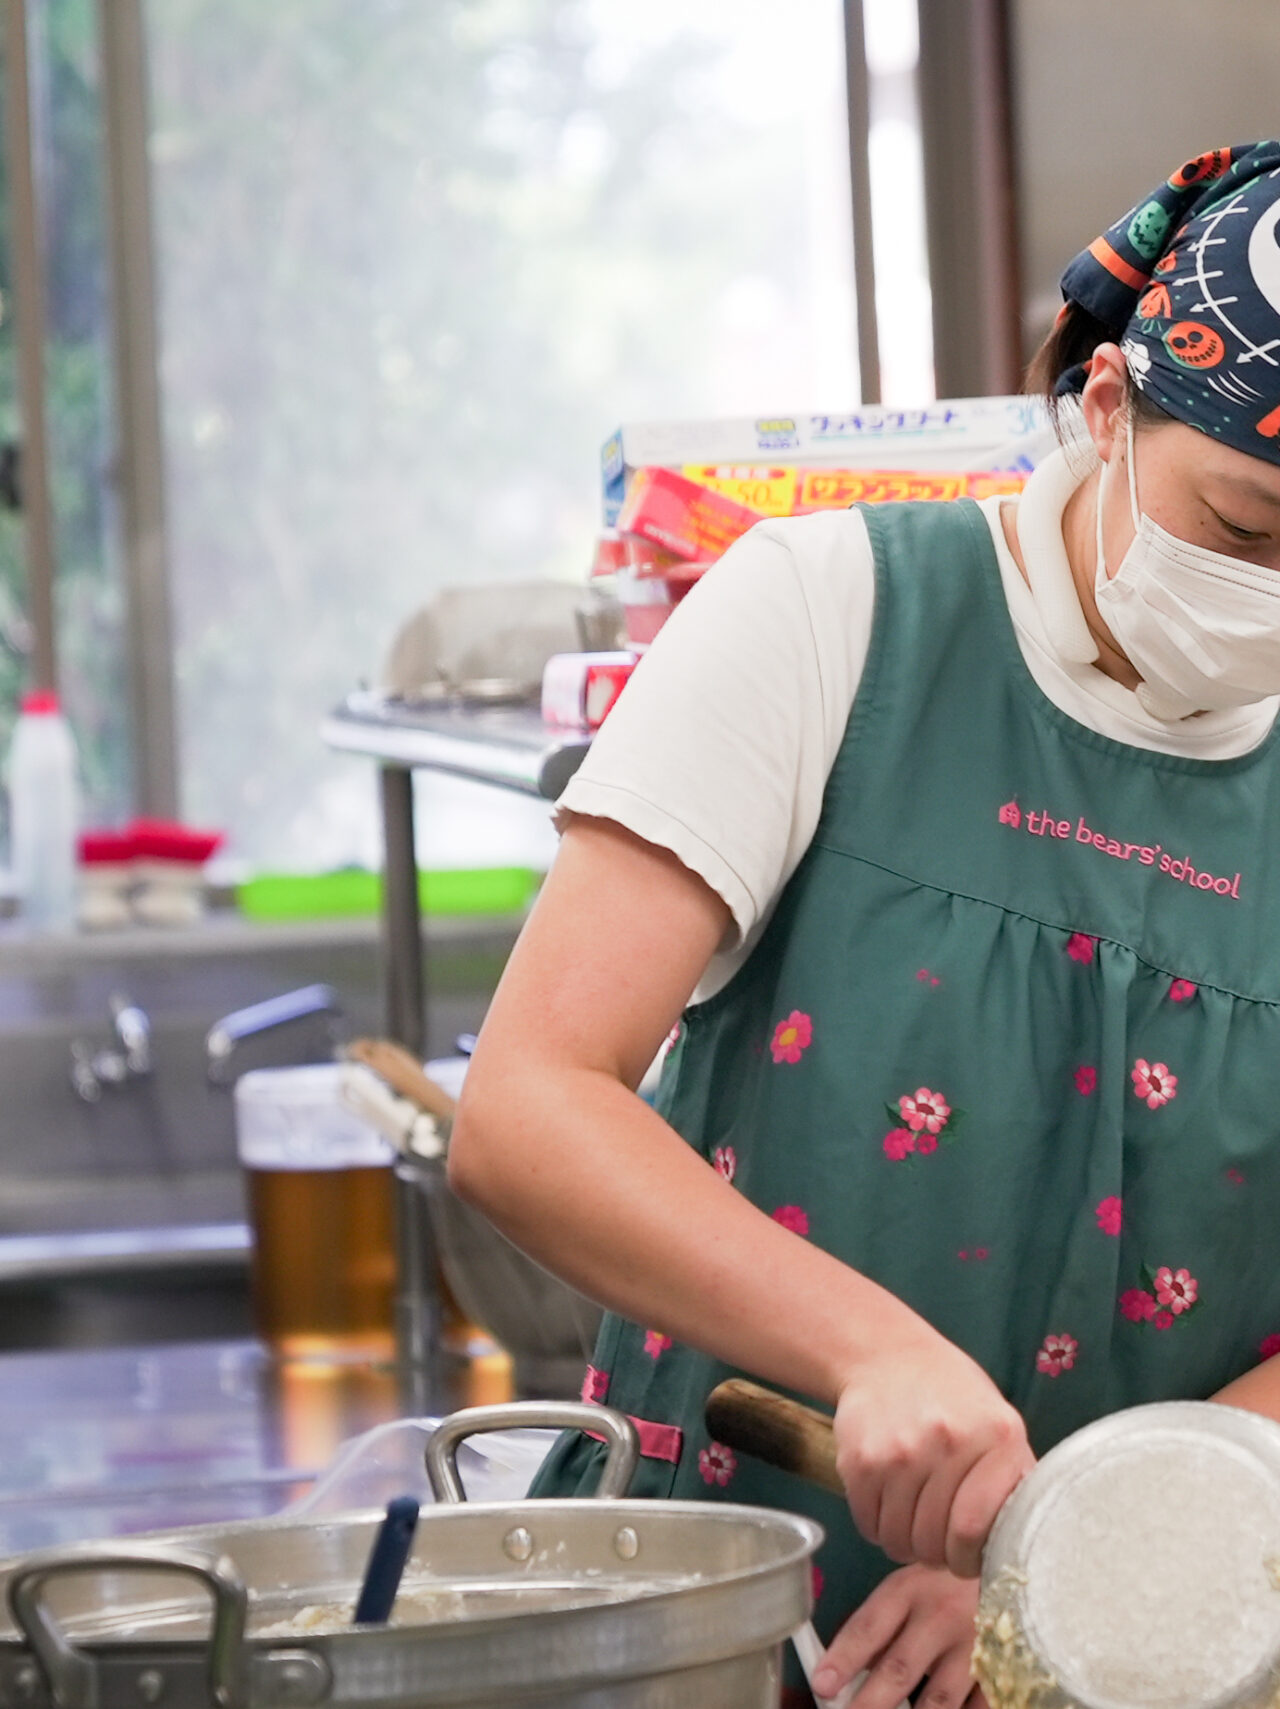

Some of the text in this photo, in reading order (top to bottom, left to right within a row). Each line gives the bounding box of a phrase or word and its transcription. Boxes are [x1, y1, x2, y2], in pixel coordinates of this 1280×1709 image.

[1025, 809, 1242, 900] the bears' school
